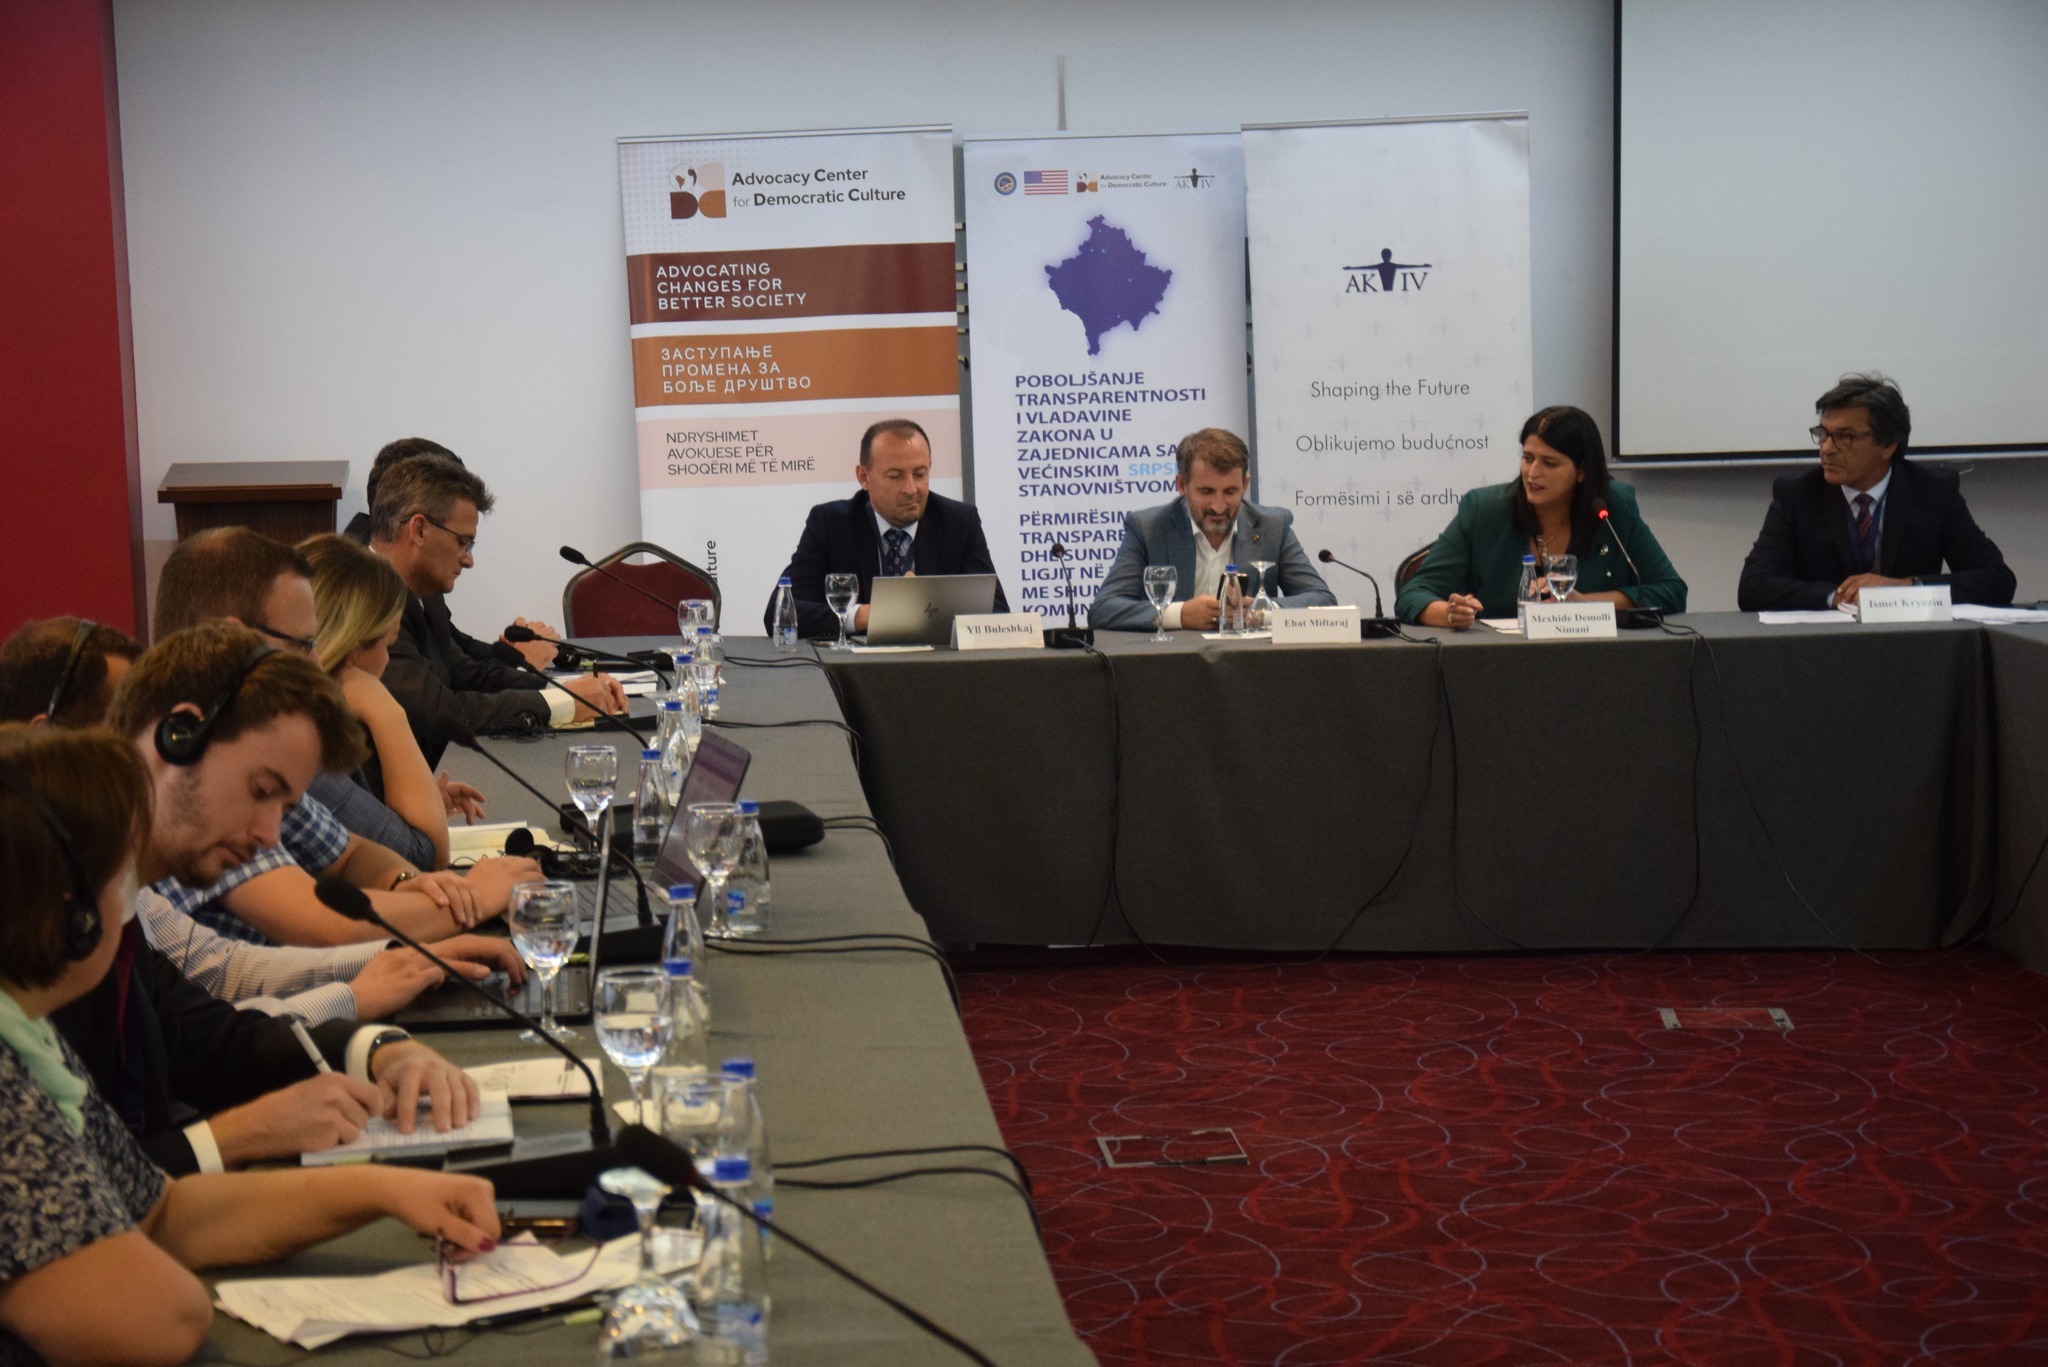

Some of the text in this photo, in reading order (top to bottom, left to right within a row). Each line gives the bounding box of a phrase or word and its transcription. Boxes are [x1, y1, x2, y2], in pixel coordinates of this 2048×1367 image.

[731, 168, 869, 187] Advocacy Center
[1100, 173, 1130, 181] Advocacy
[732, 187, 906, 208] for Democratic Culture
[656, 262, 770, 279] ADVOCATING
[657, 278, 782, 294] CHANGES FOR
[658, 293, 807, 310] BETTER SOCIETY
[661, 345, 773, 361] ЗАСТУПАЊЕ
[662, 361, 781, 377] ПРОМЕНА ЗА
[663, 376, 812, 394] БОЉЕ ДРУШТВО
[1015, 370, 1145, 388] POBOLJŠANJE
[1015, 388, 1206, 406] TRANSPARENTNOSTI
[1311, 379, 1470, 400] Shaping the Future
[1016, 409, 1132, 425] I VLADAVINE
[666, 430, 759, 444] NDRYSHIMET
[1017, 428, 1113, 443] ZAKONA U
[1296, 433, 1490, 455] Oblikujemo budućnost
[667, 443, 774, 460] AVOKUESE PËR
[1017, 444, 1178, 461] ZAJEDNICAMA SA
[667, 456, 816, 476] SHOQËRI MË TË MIRË
[1018, 463, 1119, 480] VEĆINSKIM
[1018, 478, 1178, 497] STANOVNIŠTVOM
[1295, 488, 1464, 507] Formësimi i së ardh
[705, 540, 719, 583] lture
[1063, 547, 1120, 562] SUND
[1021, 563, 1105, 581] LIGJIT NË
[1022, 586, 1049, 600] ME
[1868, 599, 1898, 609] Ismet
[1284, 618, 1349, 629] Ehat Miftaraj
[1531, 613, 1611, 623] Mexhide Demolli
[966, 624, 1033, 634] Yll Buleshkaj
[1555, 625, 1590, 634] Nimani
